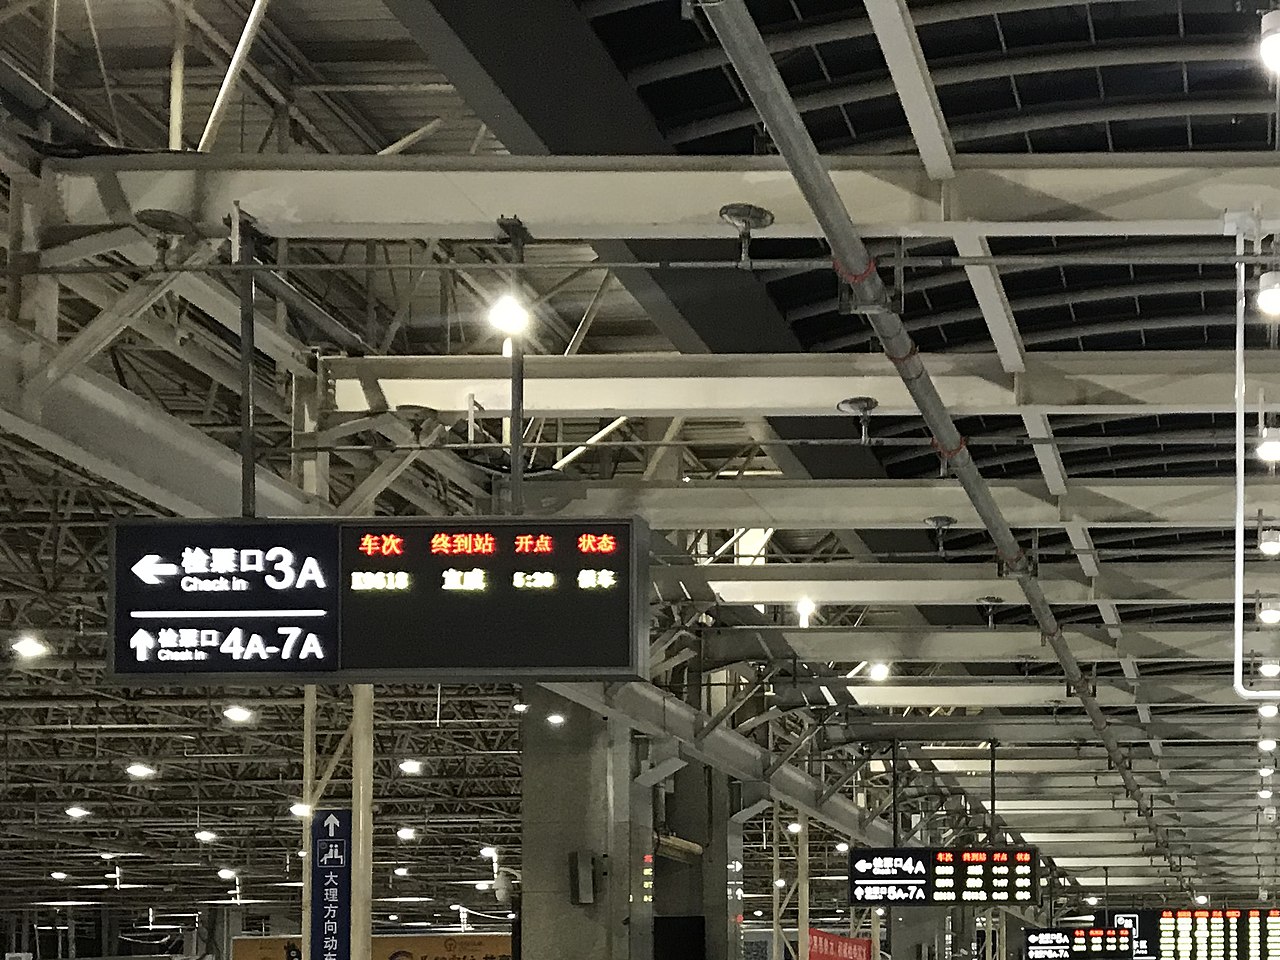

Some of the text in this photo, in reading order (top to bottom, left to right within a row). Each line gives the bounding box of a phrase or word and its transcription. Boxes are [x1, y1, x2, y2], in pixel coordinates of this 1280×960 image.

[359, 533, 616, 555] 车次 终到站 开点 状态
[180, 546, 327, 590] 检票口 3A
[219, 626, 325, 660] 4A-7A
